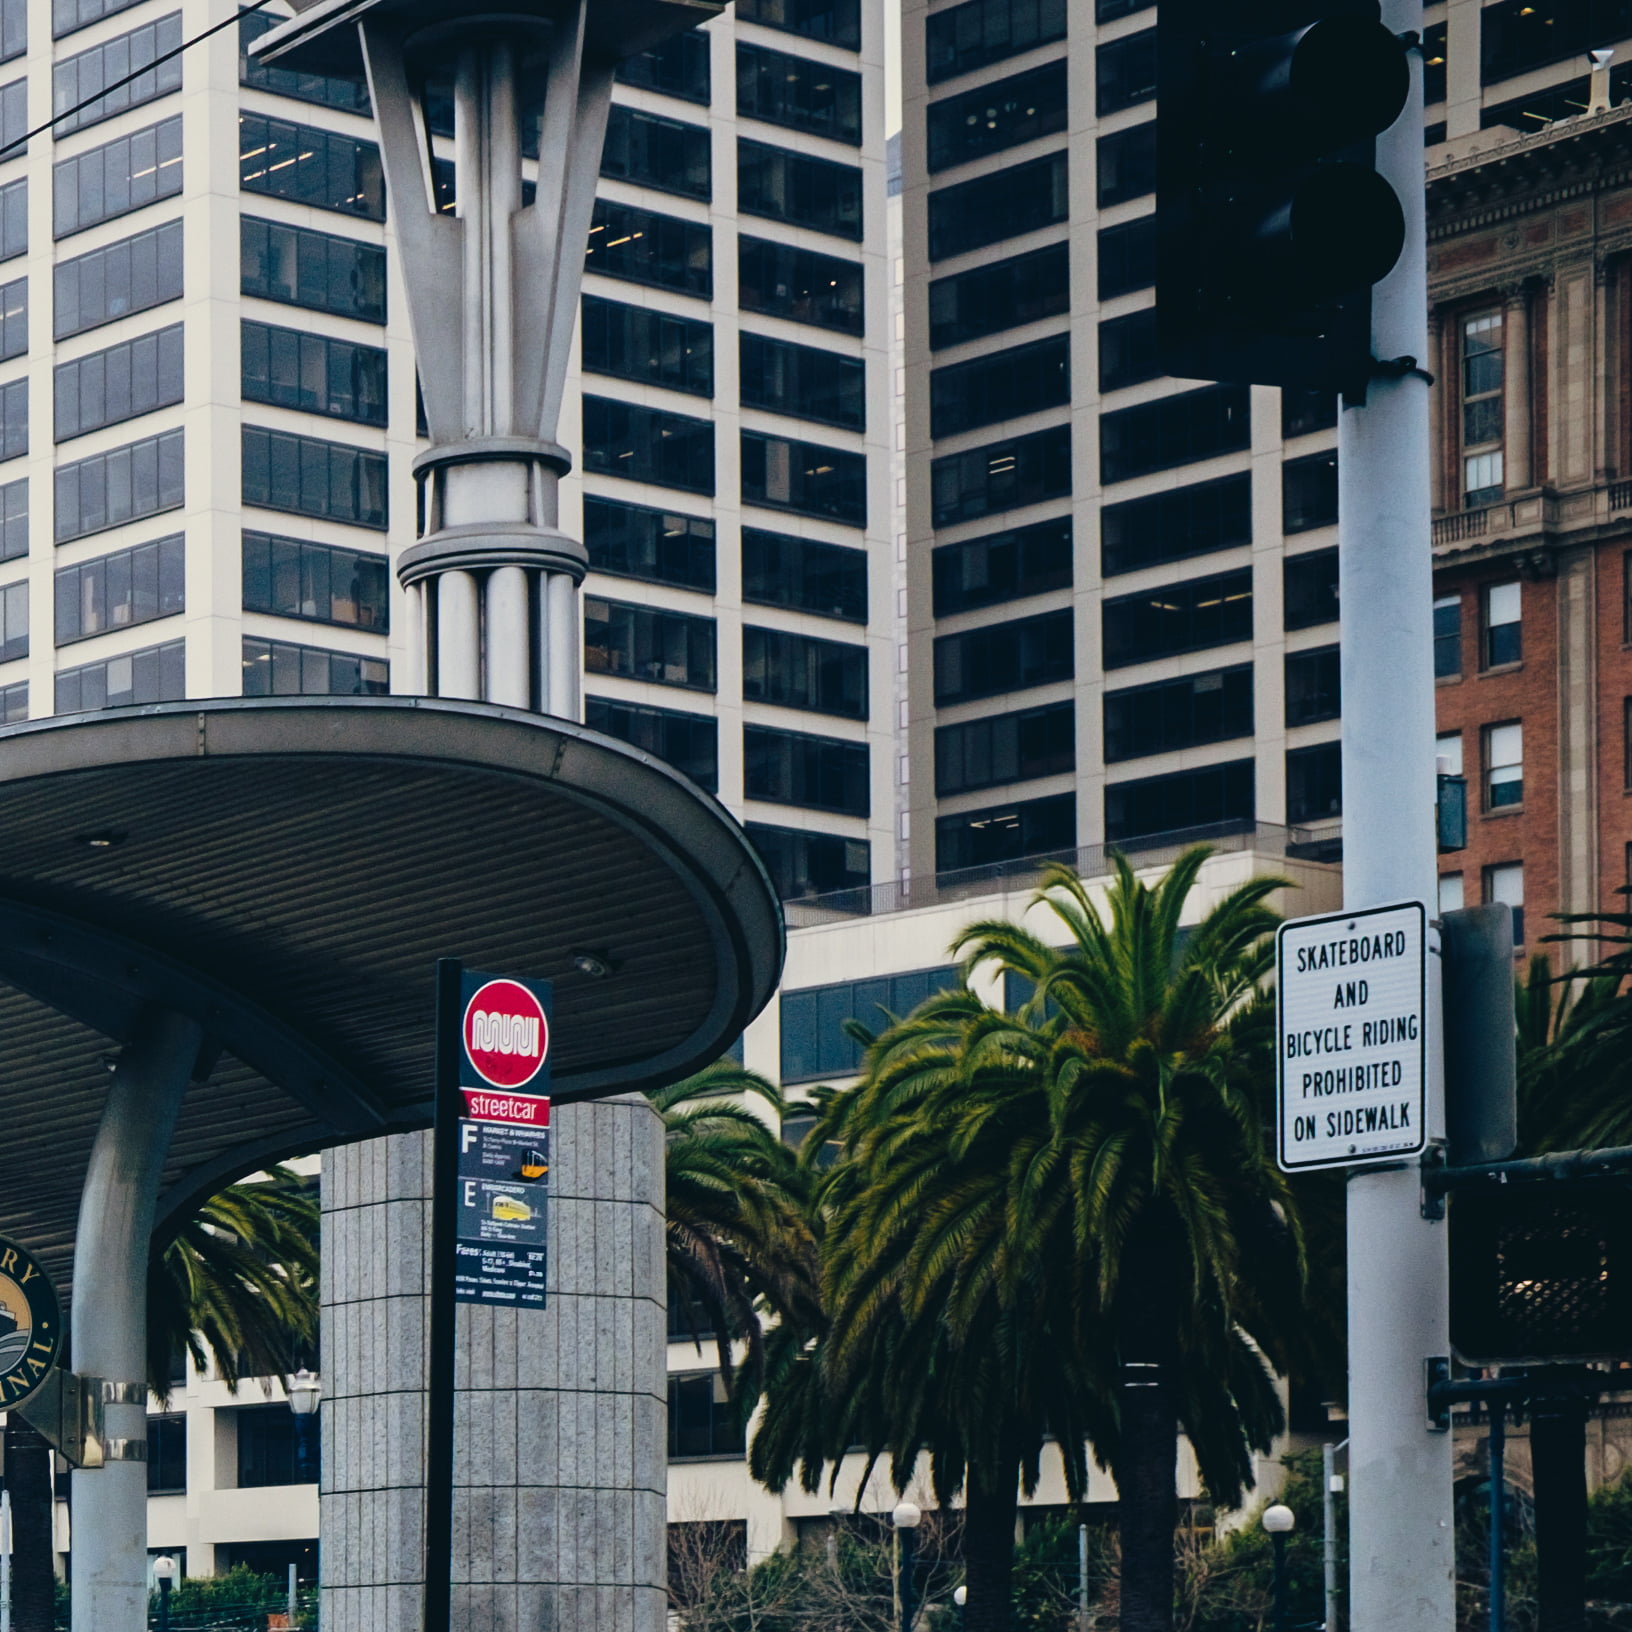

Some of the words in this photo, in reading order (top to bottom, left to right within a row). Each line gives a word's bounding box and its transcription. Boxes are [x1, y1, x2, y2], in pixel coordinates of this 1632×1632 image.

[1297, 930, 1406, 973] SKATEBOARD
[1334, 979, 1369, 1009] AND
[1287, 1024, 1352, 1059] BICYCLE
[1362, 1014, 1418, 1047] RIDING
[1302, 1060, 1402, 1099] PROHIBITED
[471, 1095, 537, 1120] streetcar
[1294, 1114, 1316, 1142] ON
[1326, 1101, 1410, 1138] SIDEWALK
[462, 1124, 478, 1153] F
[464, 1181, 476, 1208] E
